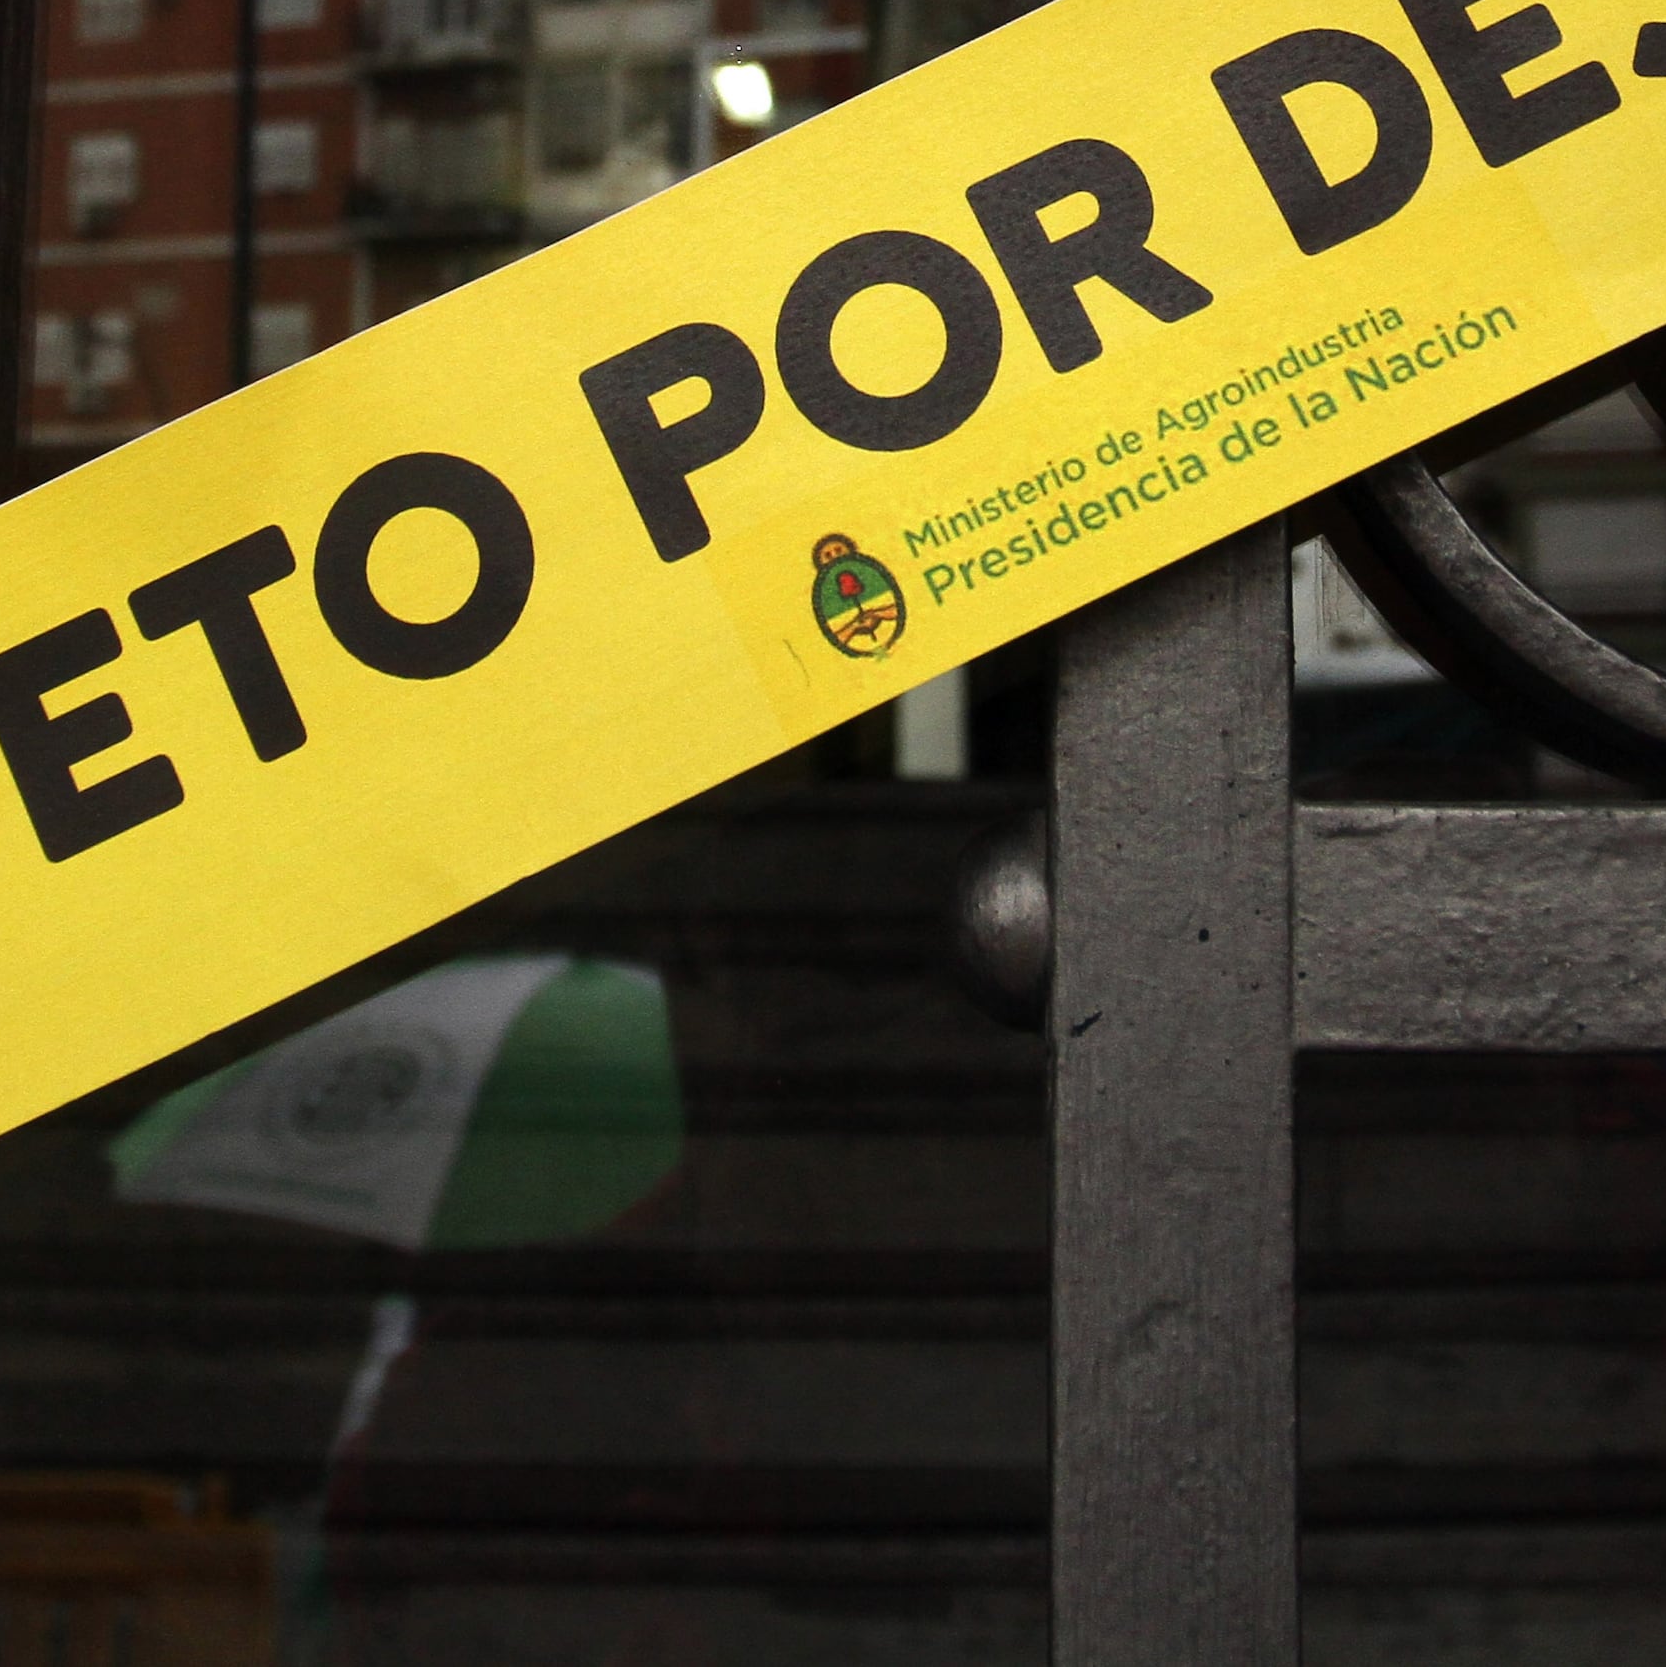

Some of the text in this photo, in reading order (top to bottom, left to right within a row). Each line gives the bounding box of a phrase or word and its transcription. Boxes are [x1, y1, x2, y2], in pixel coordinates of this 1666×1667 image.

[578, 138, 1214, 564] POR
[903, 306, 1405, 559] Ministerio de Agroindustria
[922, 306, 1518, 607] Presidencia de la Nación
